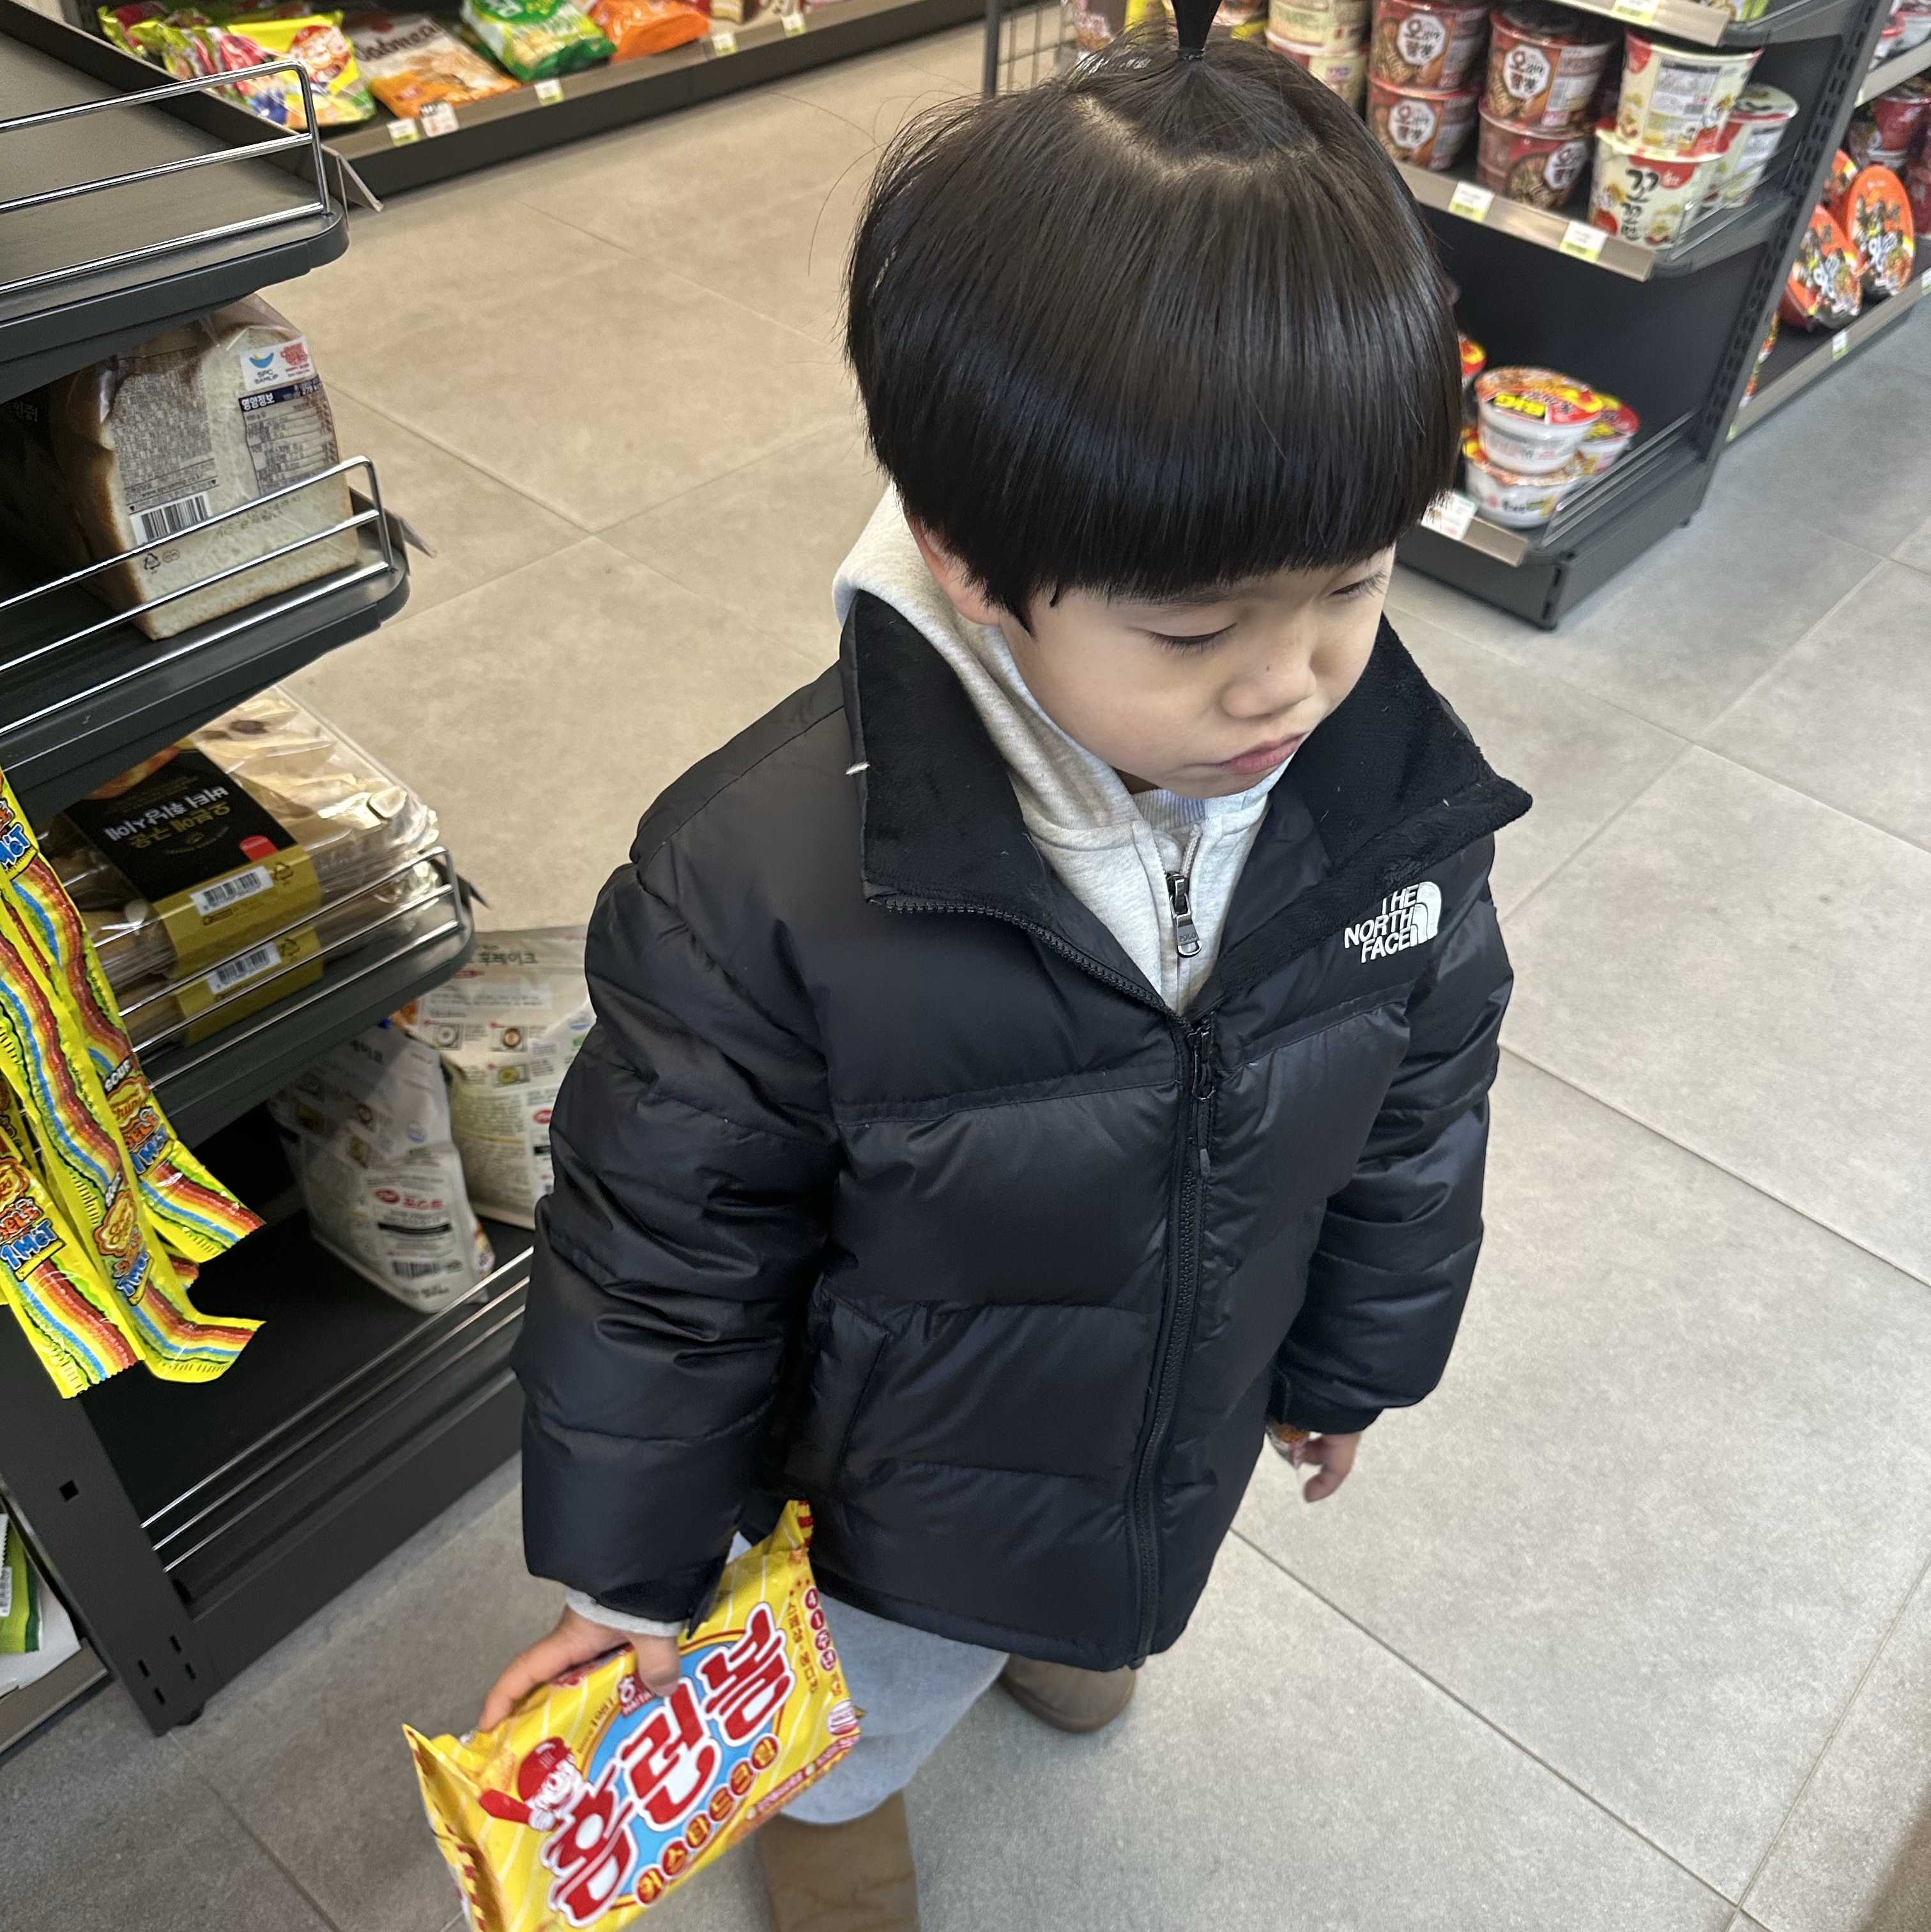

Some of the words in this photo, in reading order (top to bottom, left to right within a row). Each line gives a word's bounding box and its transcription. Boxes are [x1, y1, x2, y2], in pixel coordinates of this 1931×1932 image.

[241, 392, 275, 411] 영양정보
[183, 785, 230, 809] 버터
[103, 802, 188, 842] 휘낭시에
[1382, 884, 1419, 915] THE
[1179, 932, 1197, 943] POLO
[1344, 906, 1415, 948] NORTH
[1361, 926, 1412, 963] FACE
[622, 1690, 654, 1715] HAITA
[543, 1602, 795, 1925] 홈런볼
